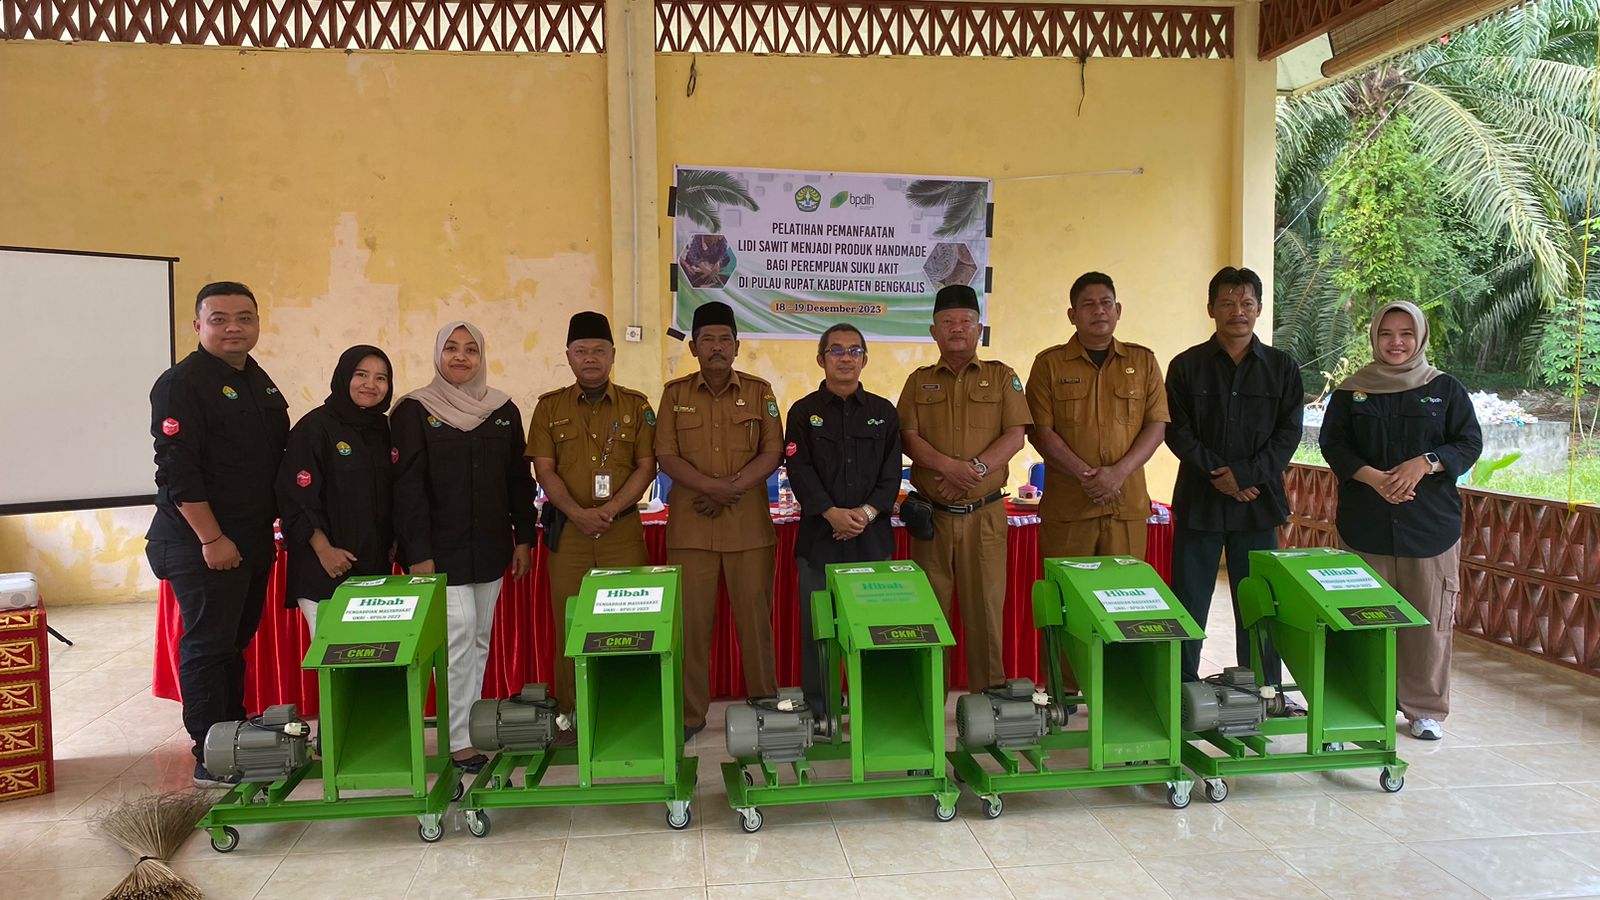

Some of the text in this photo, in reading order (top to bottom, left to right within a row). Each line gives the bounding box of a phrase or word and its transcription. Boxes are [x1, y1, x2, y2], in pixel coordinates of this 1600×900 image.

[850, 192, 874, 208] bpdlh
[772, 222, 895, 238] PELATIHAN PEMANFAATAN
[738, 240, 927, 258] LIDI SAWIT MENJADI PRODUK HANDMADE
[766, 258, 899, 274] BAGI PEREMPUAN SUKU AKIT
[738, 276, 925, 294] DI PULAU RUPAT KABUPATEN BENGKALIS
[776, 303, 786, 311] 18
[794, 304, 804, 312] 19
[806, 304, 856, 313] Desember
[858, 304, 882, 314] 2023
[1318, 568, 1358, 576] Hibah
[607, 589, 650, 598] Hibah
[1104, 588, 1147, 598] Hibah
[360, 598, 404, 606] Hibah
[1138, 624, 1165, 632] CKM
[890, 630, 917, 638] CKM
[606, 637, 632, 646] CKM
[346, 648, 376, 658] CKM
